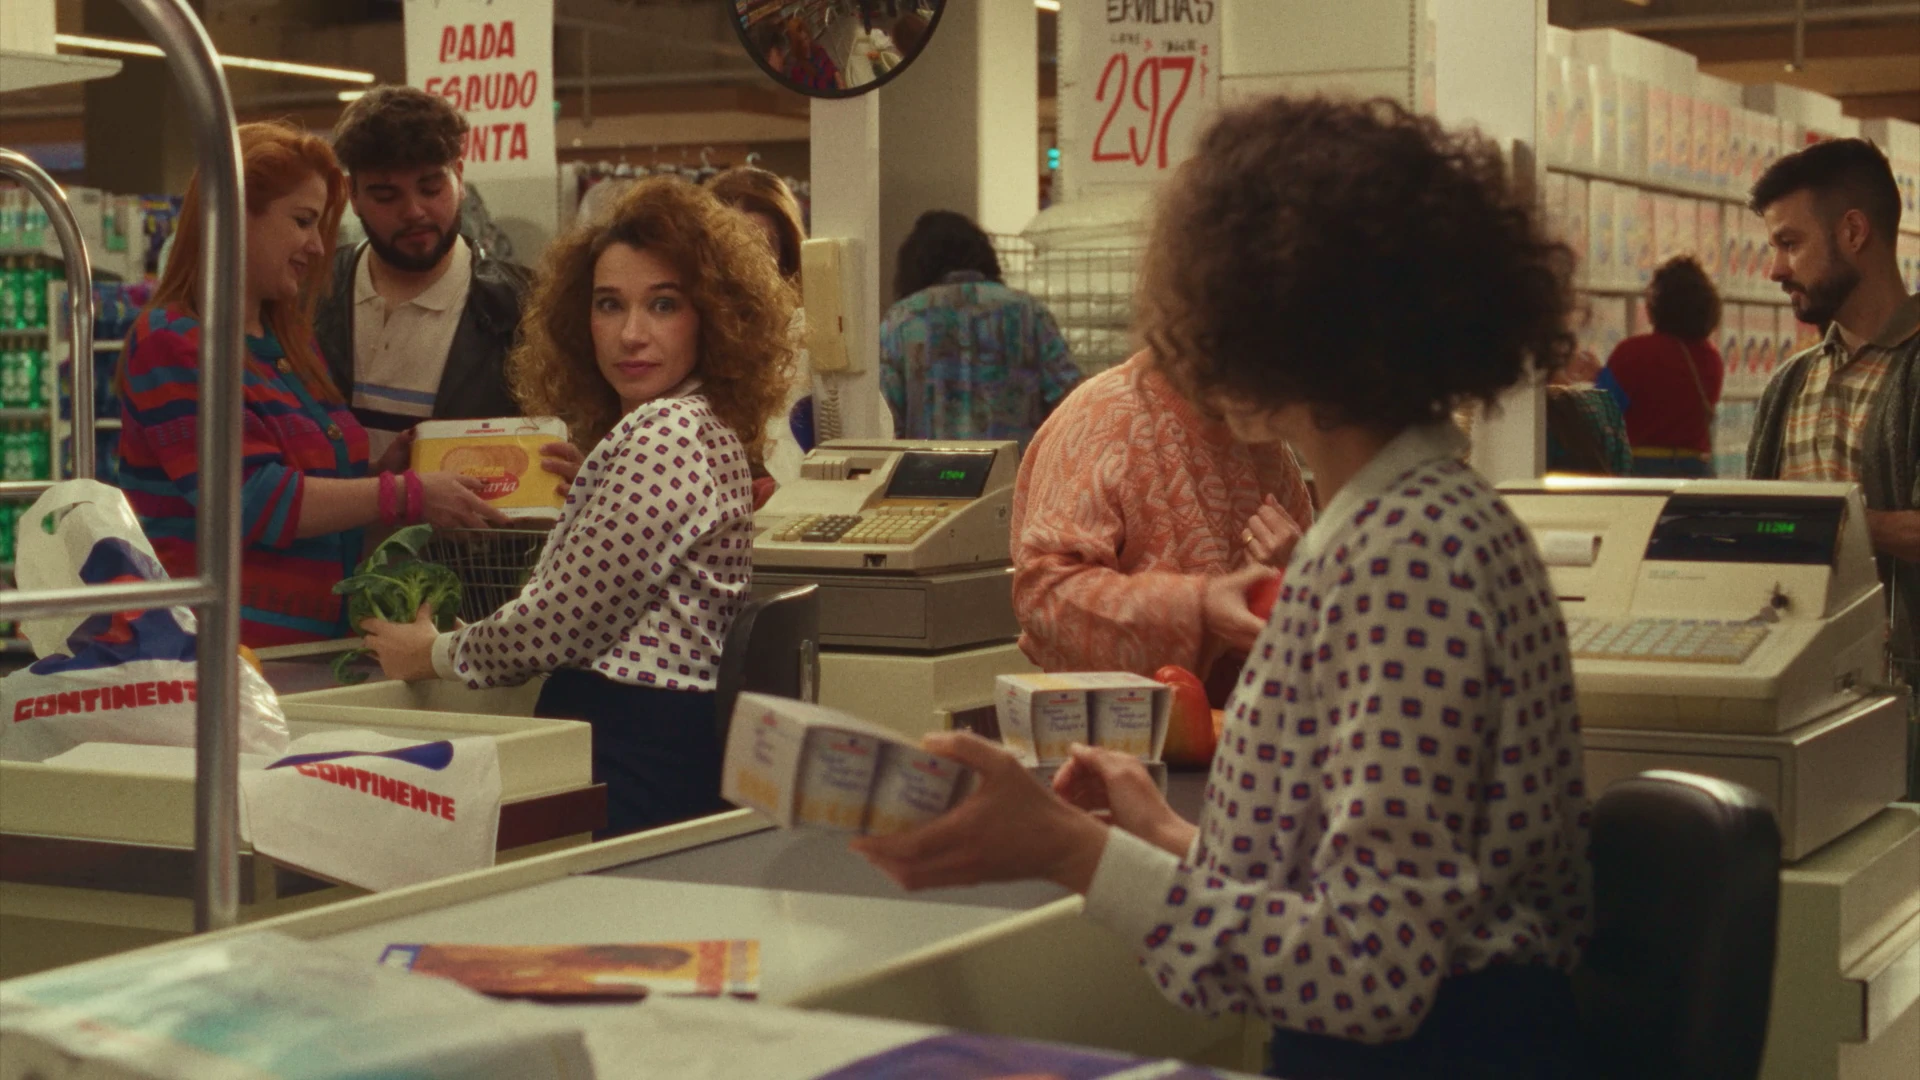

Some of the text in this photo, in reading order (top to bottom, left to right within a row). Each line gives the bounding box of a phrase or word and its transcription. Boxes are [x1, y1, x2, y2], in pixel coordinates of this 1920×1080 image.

[1092, 53, 1195, 170] 297
[480, 478, 517, 493] aria
[14, 680, 197, 723] CONTINENT
[294, 762, 455, 822] CONTINENTE
